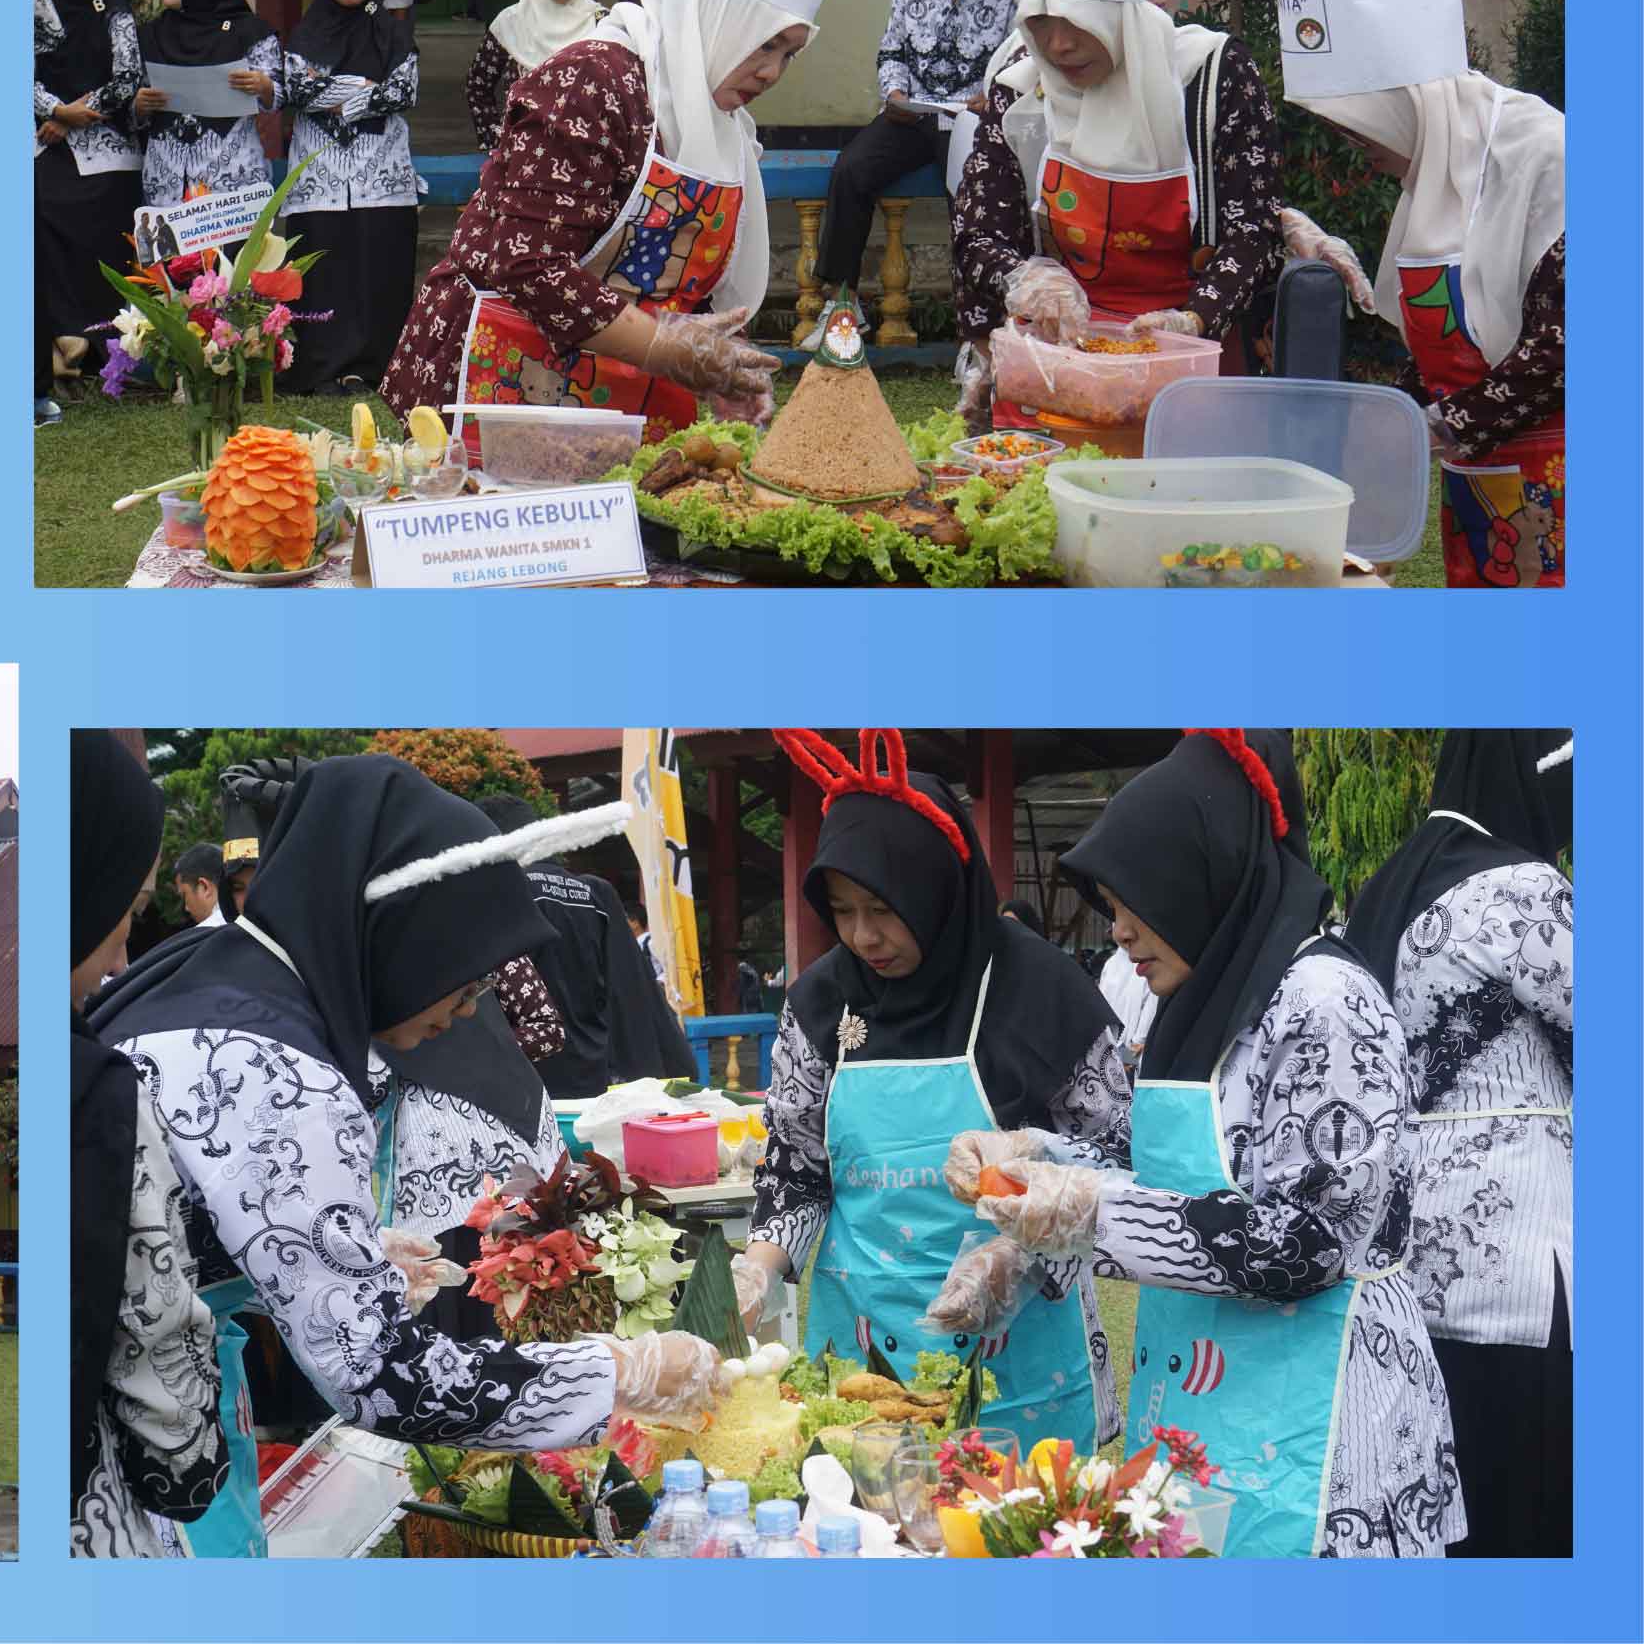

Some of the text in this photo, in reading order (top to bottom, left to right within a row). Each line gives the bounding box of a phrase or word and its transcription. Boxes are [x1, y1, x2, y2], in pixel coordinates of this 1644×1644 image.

[167, 189, 274, 222] SELAMAT HARI GURU
[180, 212, 260, 239] DHARMA WANIT
[376, 496, 625, 540] “TUMPENG KEBULLY”
[422, 537, 592, 566] DHARMA WANITA SMKN 1
[452, 561, 569, 583] REJANG LEBONG
